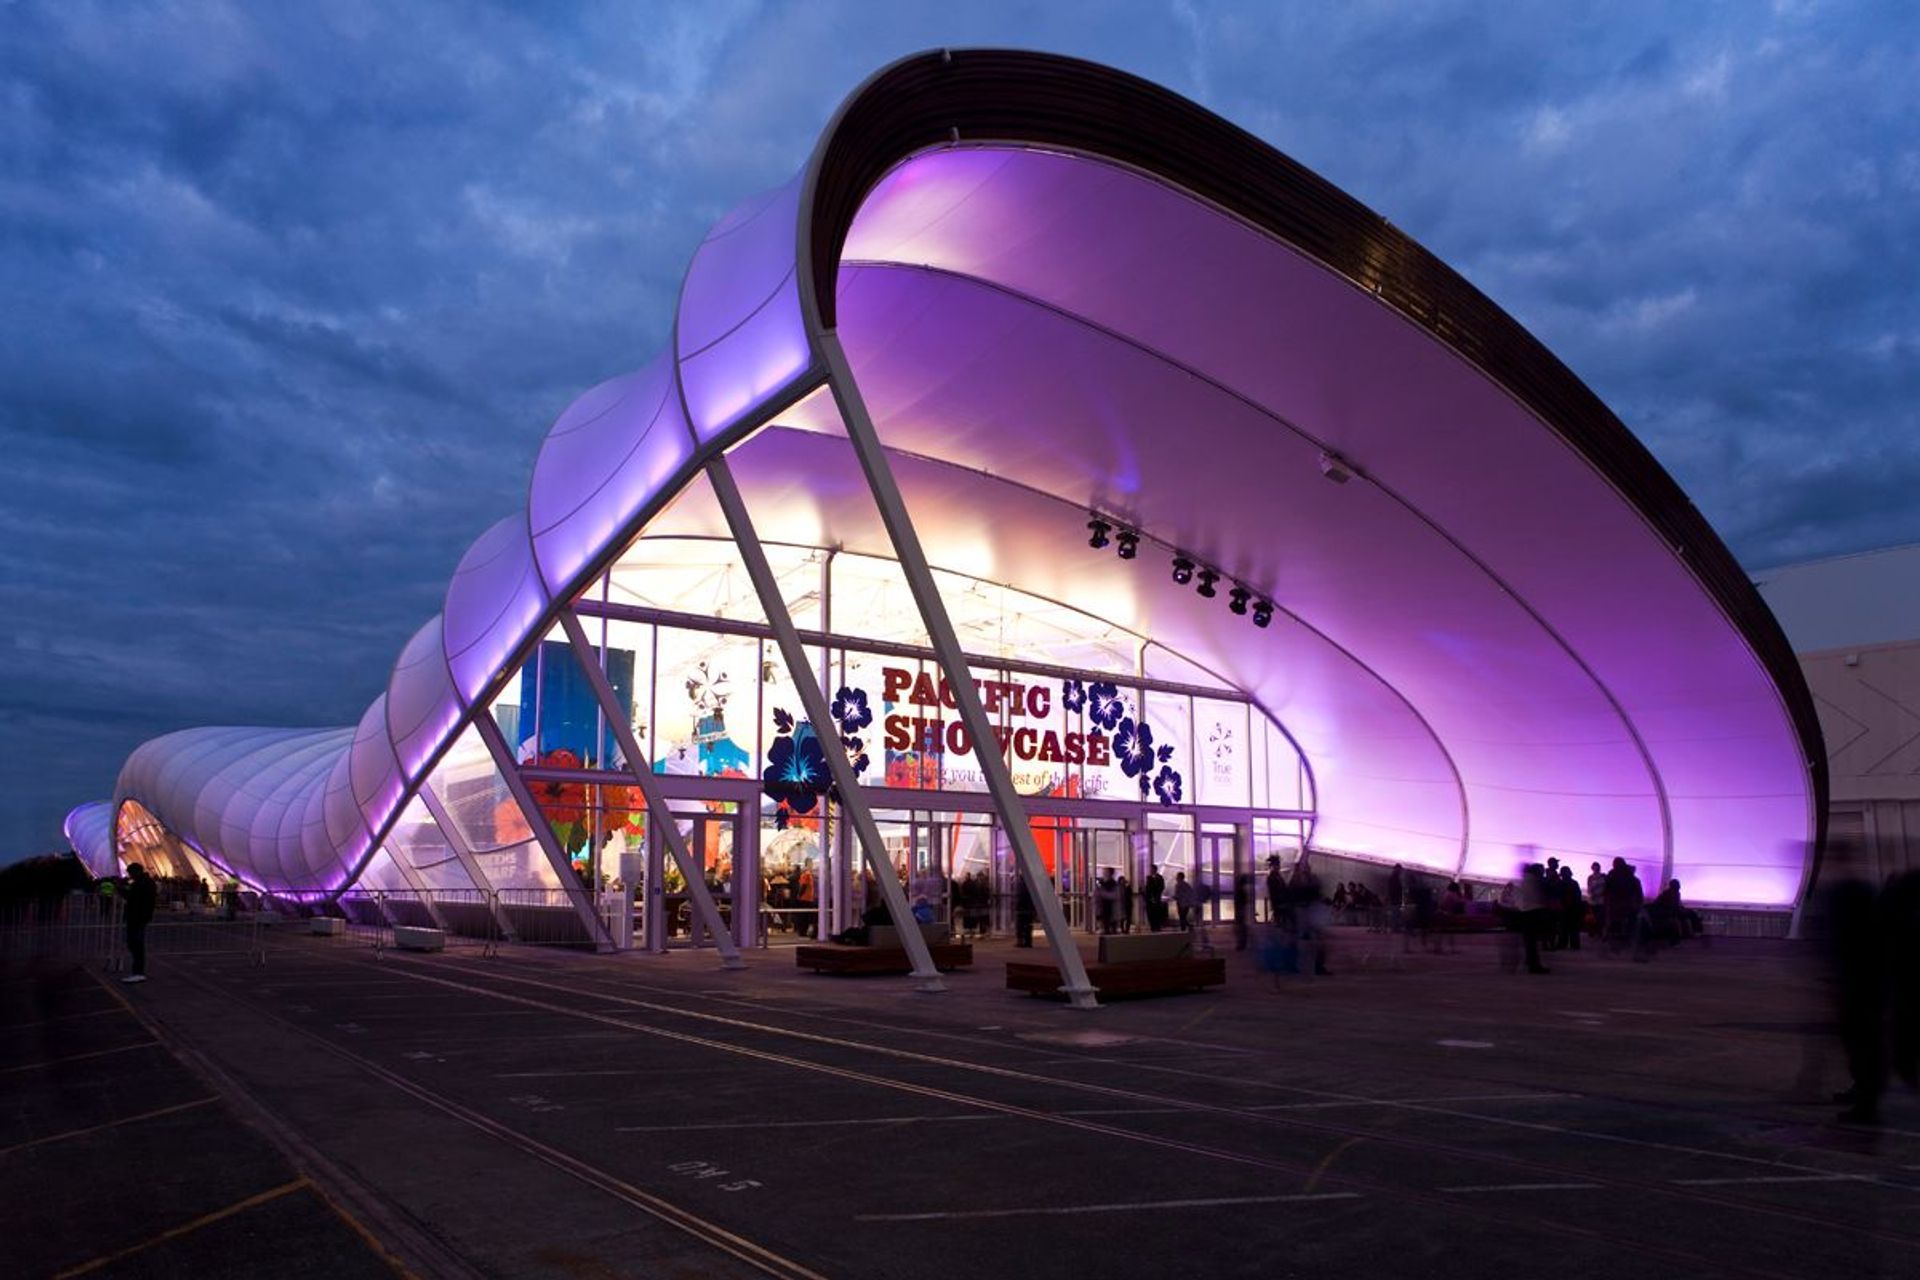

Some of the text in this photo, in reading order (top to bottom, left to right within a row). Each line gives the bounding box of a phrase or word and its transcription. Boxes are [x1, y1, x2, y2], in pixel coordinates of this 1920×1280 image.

[882, 667, 1050, 719] PACFIC
[949, 769, 975, 785] you
[1013, 773, 1031, 785] est
